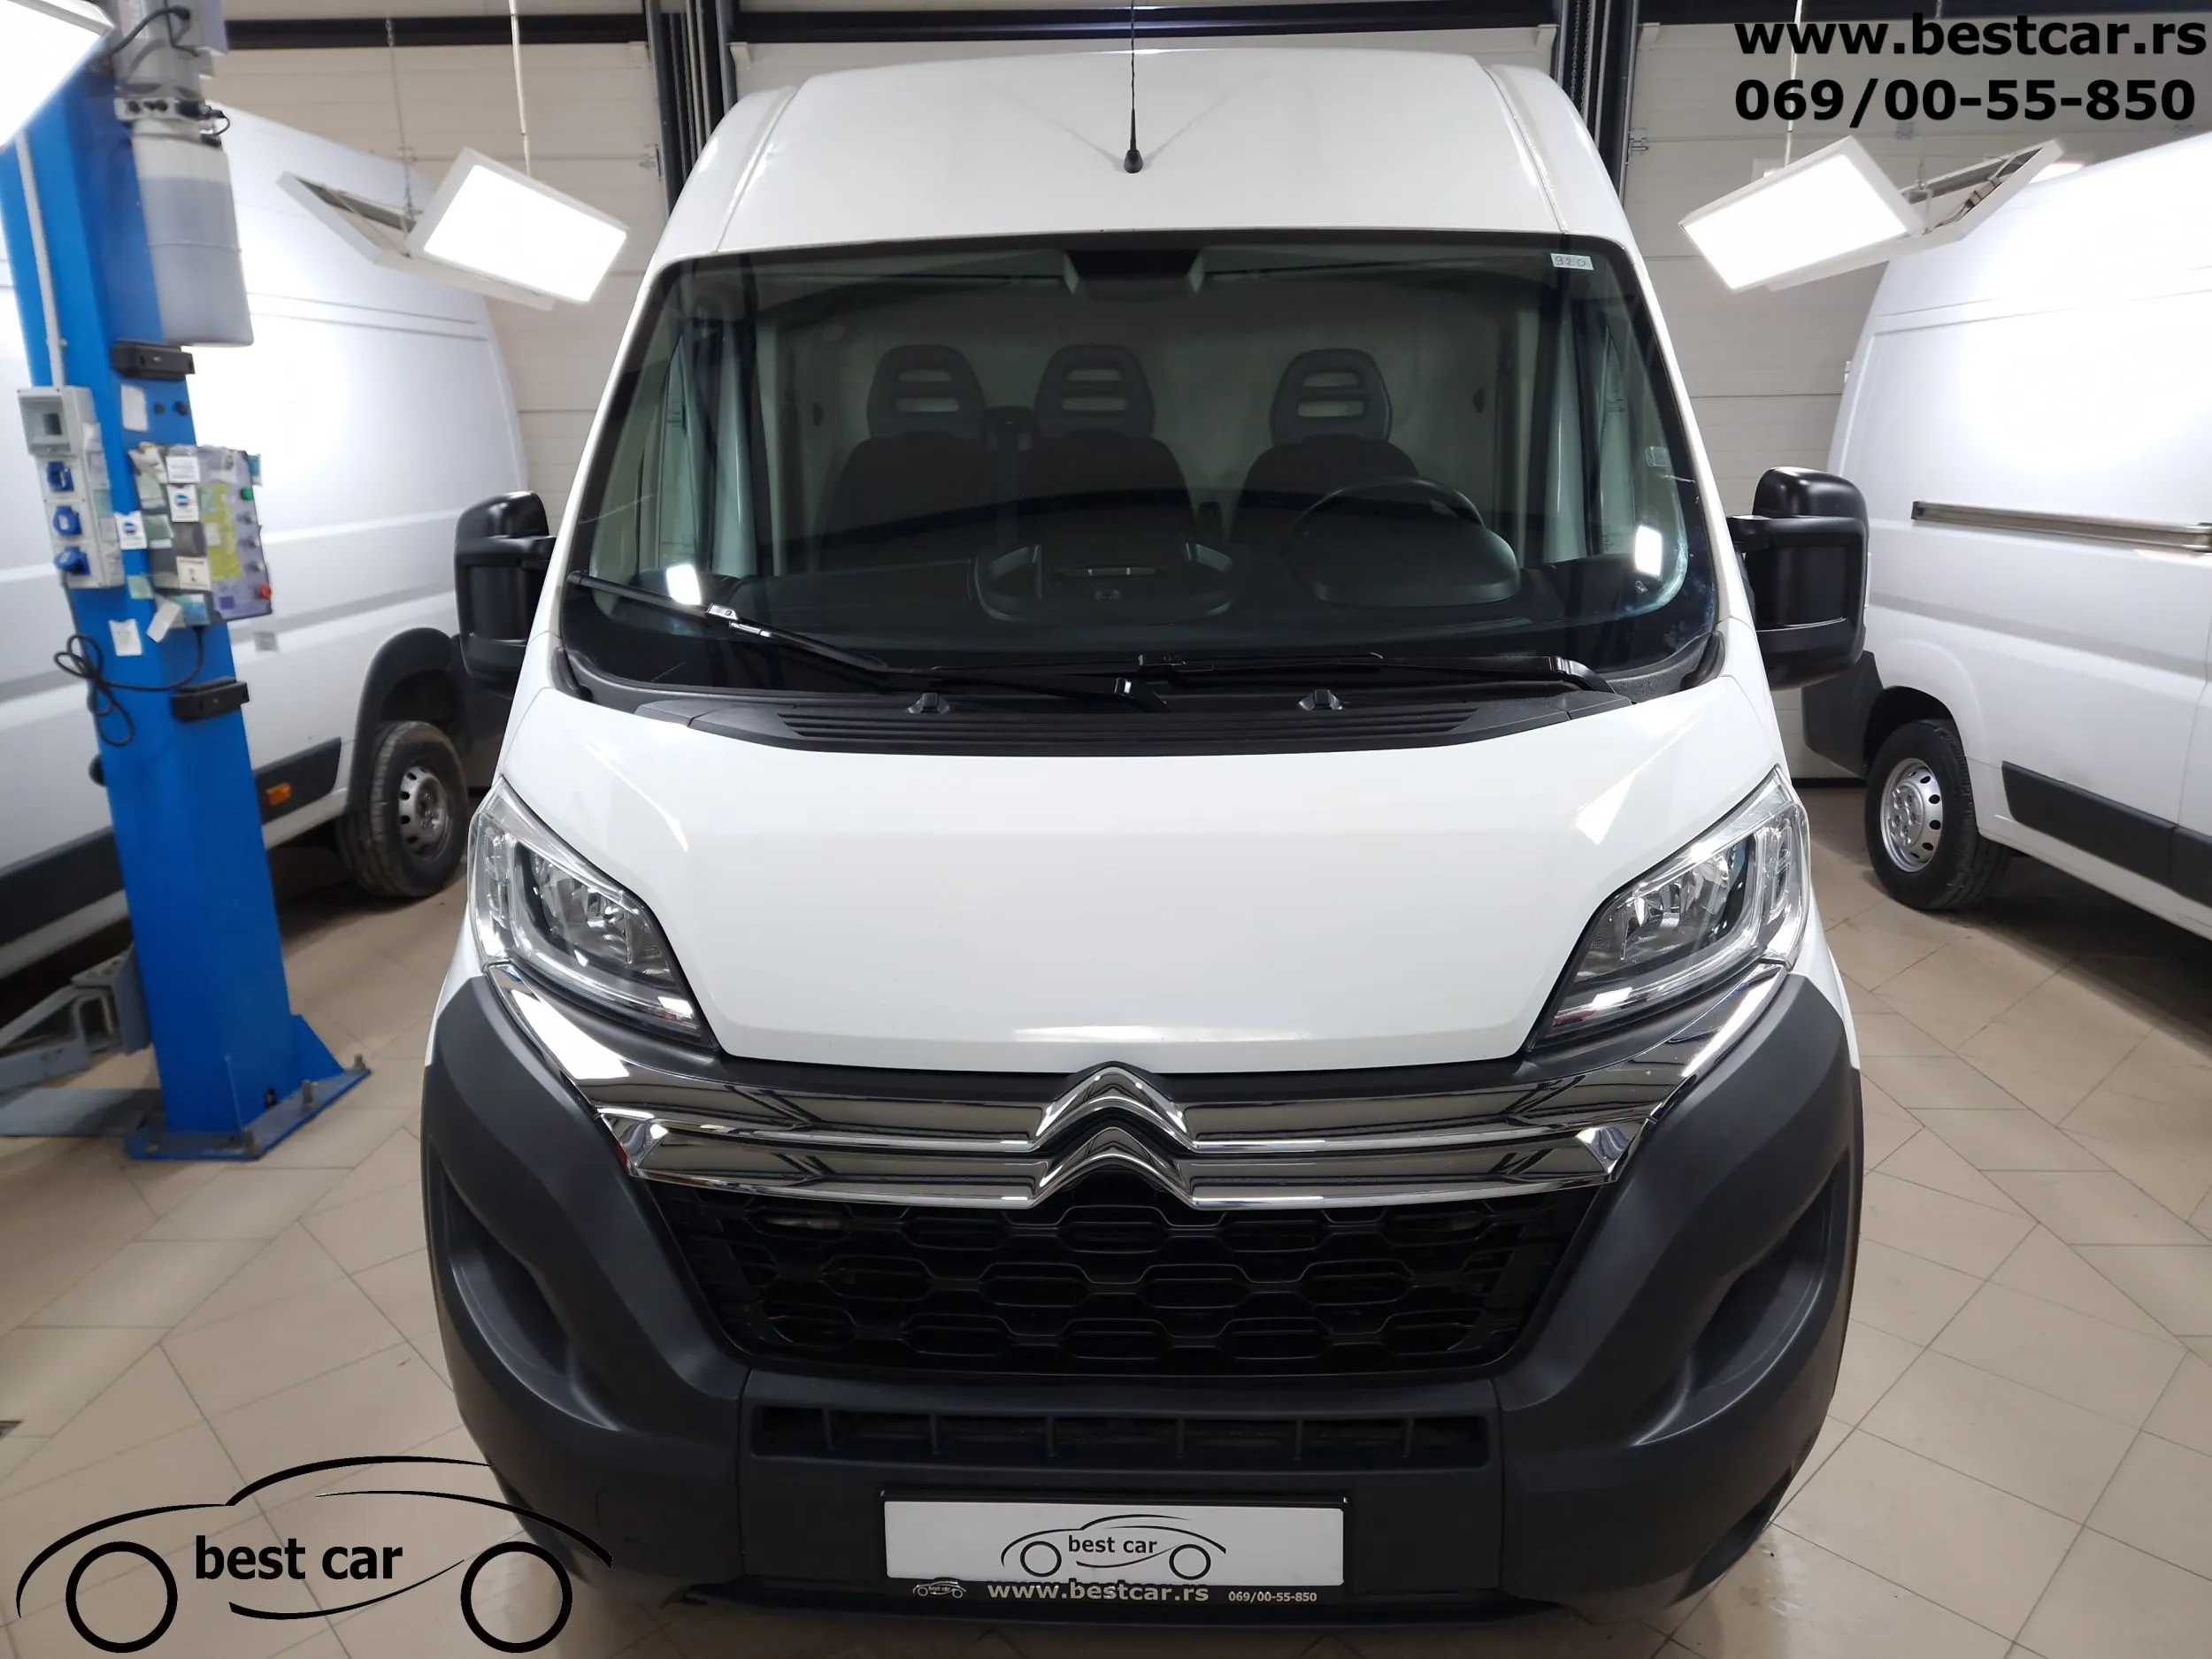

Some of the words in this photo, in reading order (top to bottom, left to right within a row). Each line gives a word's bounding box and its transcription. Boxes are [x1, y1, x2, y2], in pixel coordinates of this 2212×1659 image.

[1068, 1535, 1115, 1554] best
[1123, 1540, 1157, 1554] car
[987, 1579, 1209, 1601] www.bestcar.rs
[1228, 1591, 1317, 1602] 069/00-55-850
